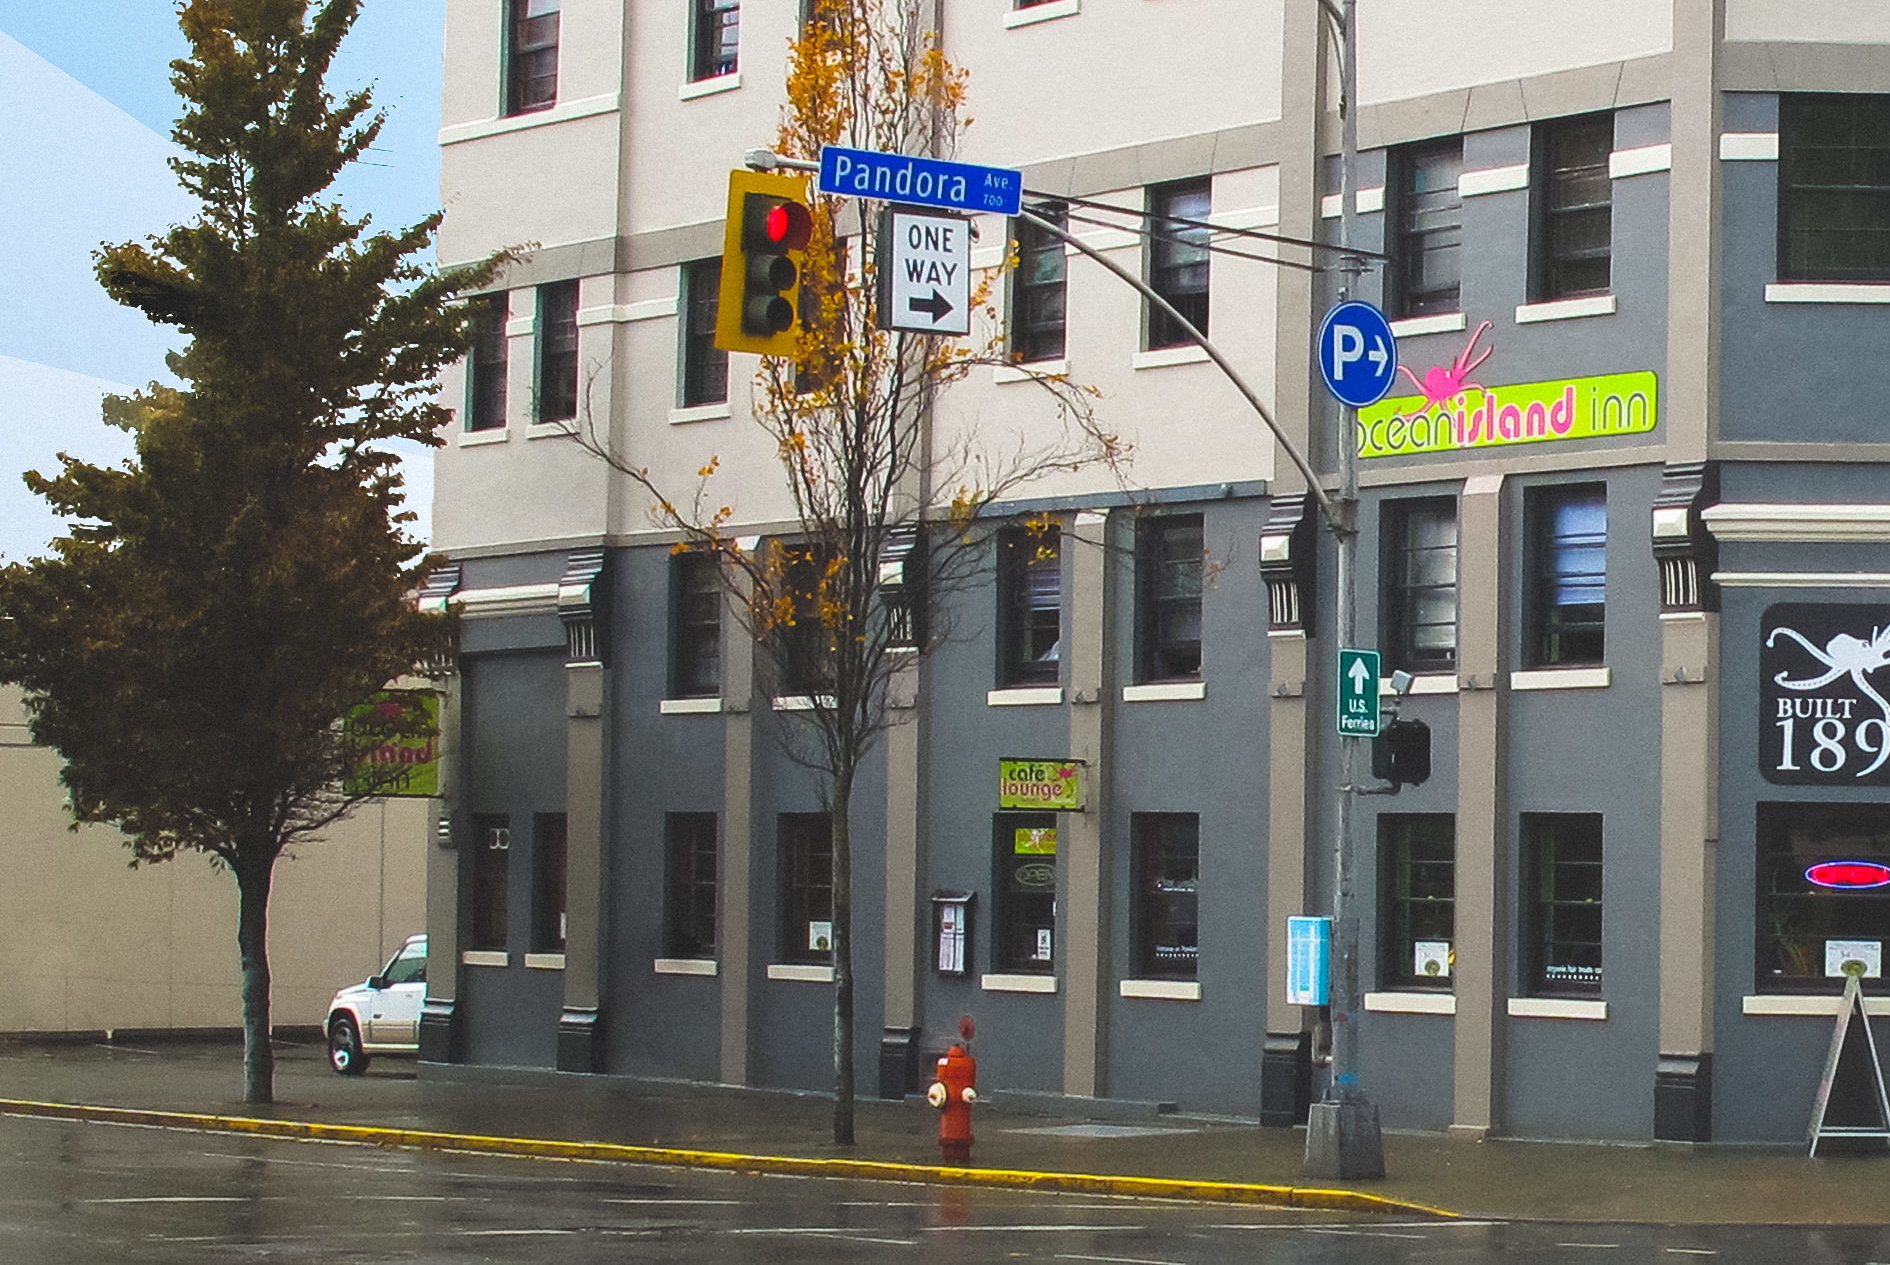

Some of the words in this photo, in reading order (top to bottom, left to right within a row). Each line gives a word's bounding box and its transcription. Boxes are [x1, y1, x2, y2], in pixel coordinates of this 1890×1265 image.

[834, 155, 967, 203] Pandora
[983, 194, 1003, 207] 700
[908, 224, 954, 254] ONE
[904, 258, 959, 286] WAY
[1333, 323, 1365, 381] P
[1590, 386, 1647, 432] inn
[1349, 698, 1369, 713] U.S.
[1776, 697, 1857, 719] BUILT
[1341, 714, 1375, 731] Ferries
[1008, 763, 1046, 782] café
[1002, 777, 1062, 801] lounge
